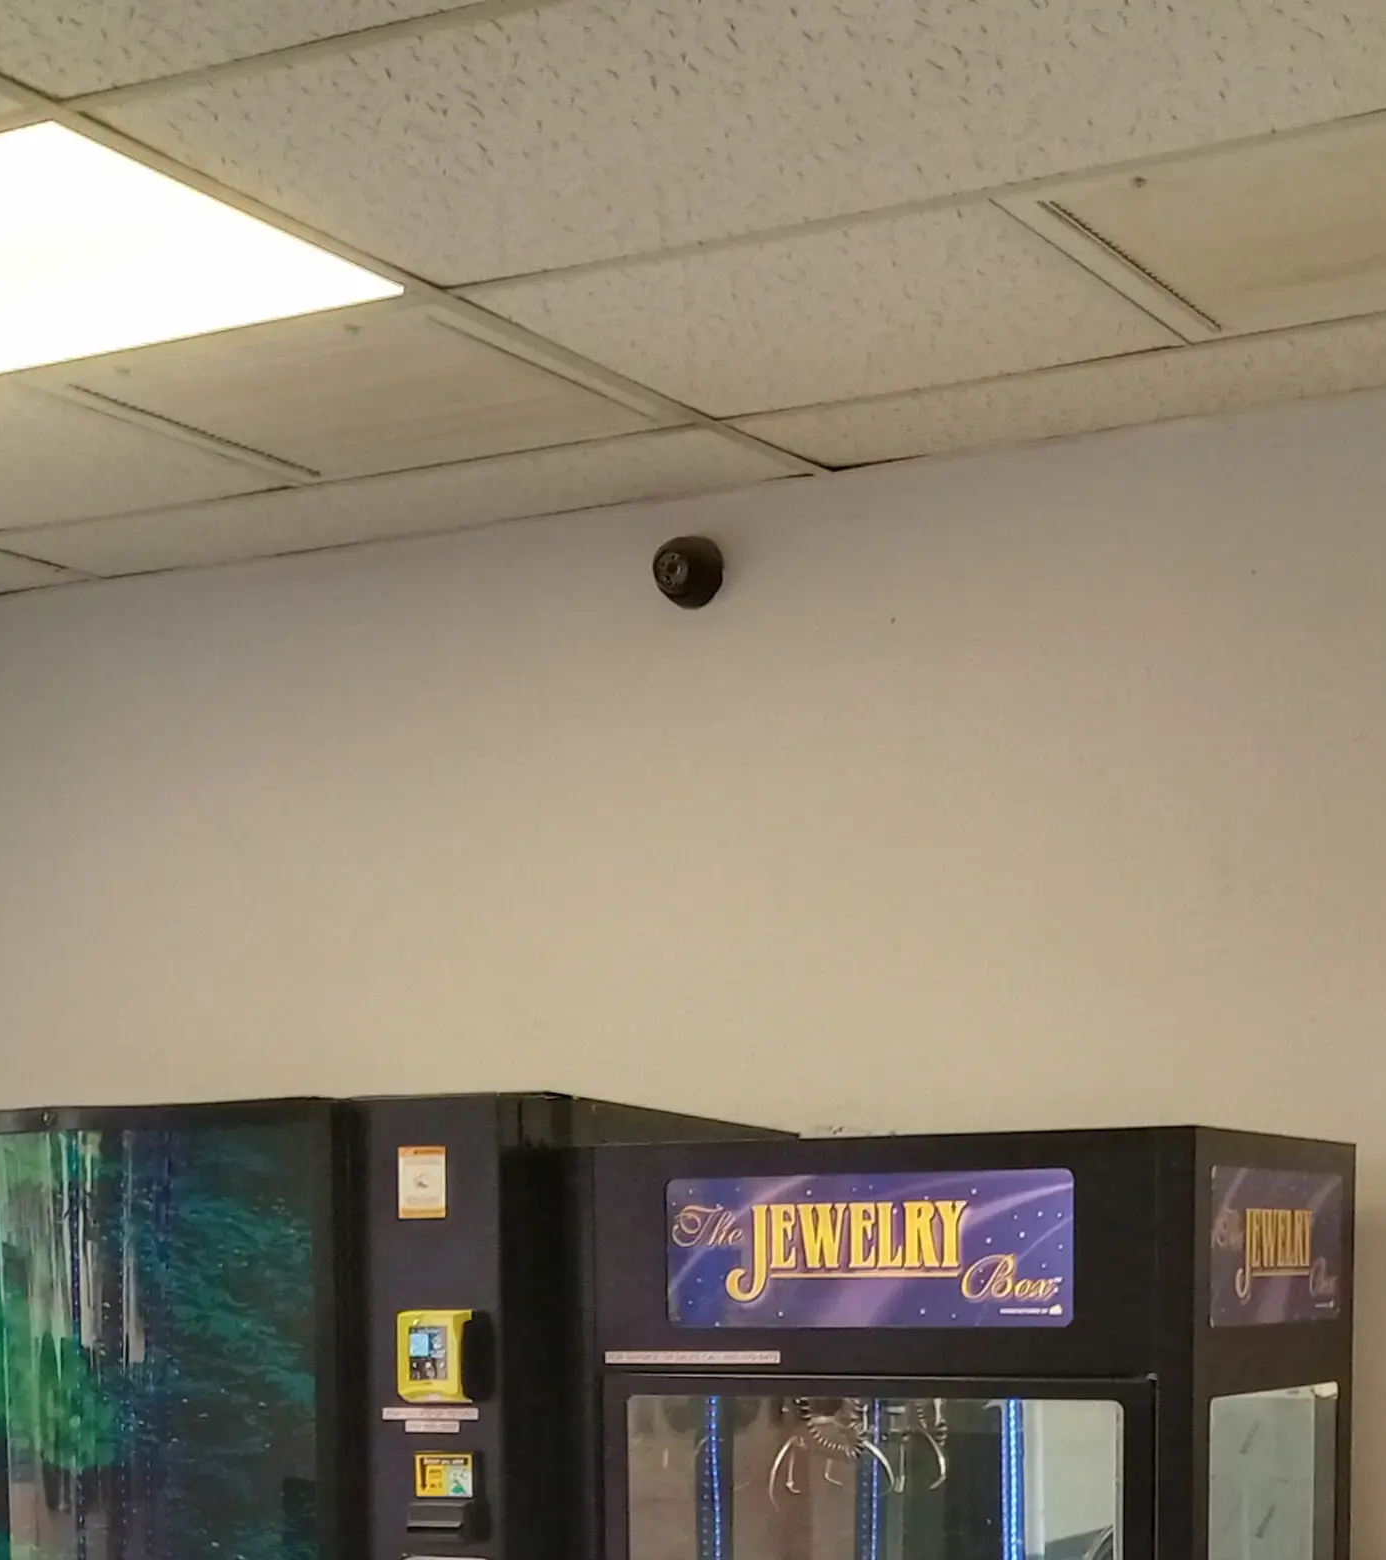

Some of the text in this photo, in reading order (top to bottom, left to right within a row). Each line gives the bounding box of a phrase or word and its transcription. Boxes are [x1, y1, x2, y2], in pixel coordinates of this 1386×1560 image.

[671, 1199, 1059, 1303] The JEWELRY Box
[1234, 1207, 1314, 1304] JEWELRY
